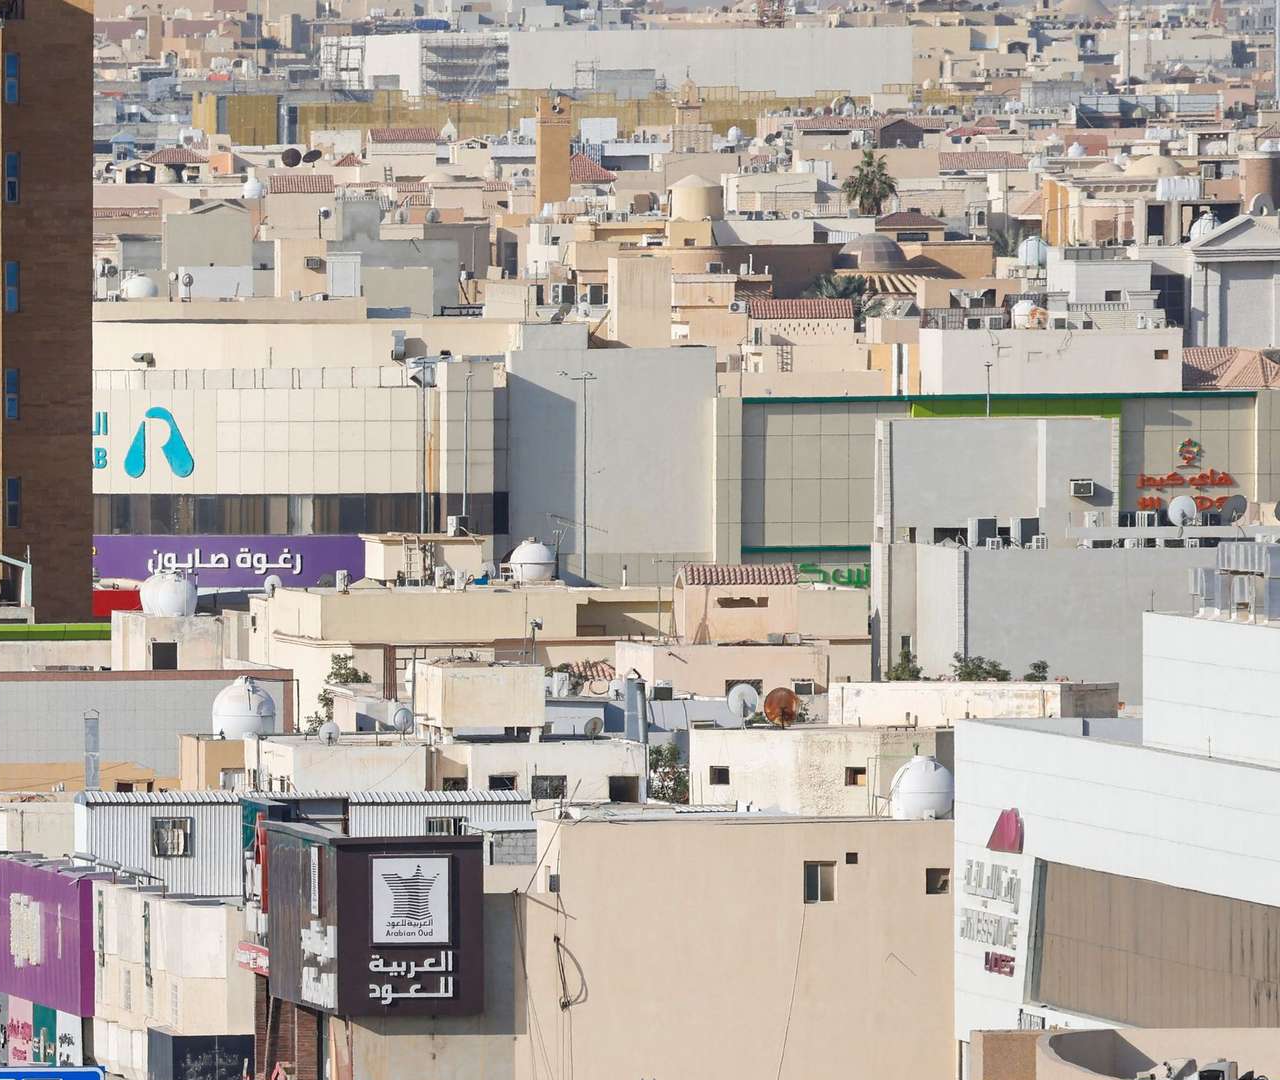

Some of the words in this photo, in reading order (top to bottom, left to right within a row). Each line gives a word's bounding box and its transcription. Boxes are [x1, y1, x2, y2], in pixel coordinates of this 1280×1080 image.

[148, 548, 230, 574] صابون
[236, 547, 304, 575] رغوة
[385, 929, 416, 937] Arabian
[417, 929, 434, 937] Oud
[386, 919, 407, 929] للعود
[407, 919, 434, 928] العربية
[368, 950, 453, 979] العربية
[368, 976, 454, 1005] للعود
